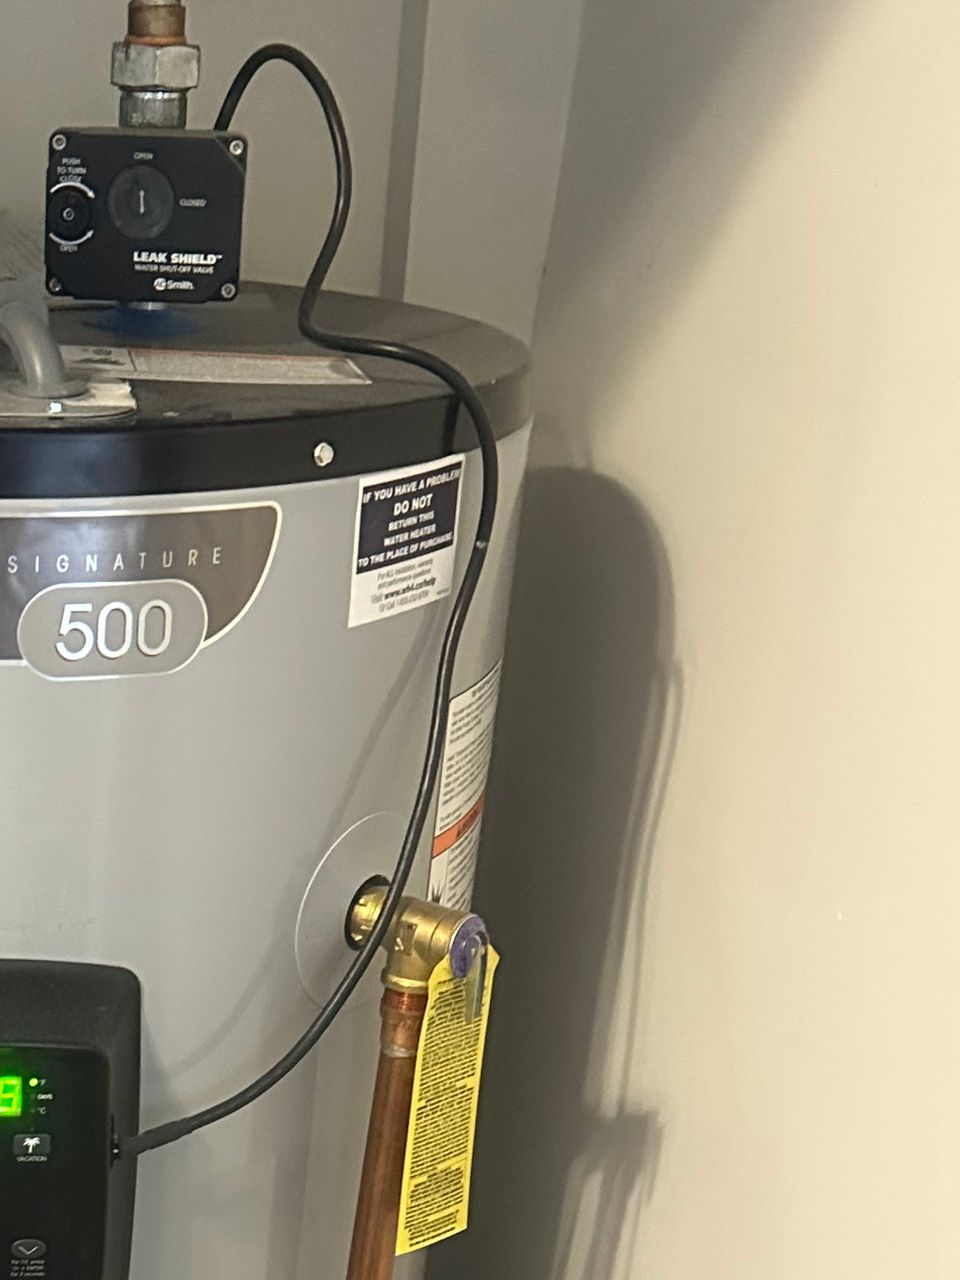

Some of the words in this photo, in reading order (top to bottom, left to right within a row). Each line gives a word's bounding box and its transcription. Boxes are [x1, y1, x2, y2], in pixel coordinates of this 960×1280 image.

[134, 152, 154, 160] OPEN
[68, 167, 87, 175] TURN
[179, 199, 207, 207] CLOSED
[59, 244, 78, 252] OPEN
[133, 251, 167, 263] LEAK
[134, 264, 158, 272] WATER
[159, 265, 191, 273] SHUT-OFF
[192, 266, 214, 274] VALVE
[362, 491, 372, 504] IF
[374, 486, 393, 502] YOU
[394, 480, 418, 497] HAVE
[418, 479, 425, 490] A
[426, 468, 461, 488] PROBLEM
[393, 500, 409, 516] DO
[411, 493, 434, 512] NOT
[388, 516, 418, 531] RETURN
[419, 510, 435, 522] THIS
[383, 531, 409, 547] WATER
[410, 523, 437, 539] HEATER
[358, 556, 370, 568] TO
[370, 552, 385, 565] THE
[386, 545, 409, 560] PLACE
[409, 543, 419, 554] OF
[419, 531, 453, 550] PURCHASE
[7, 547, 223, 574] SIGNATURE
[56, 599, 173, 661] 500
